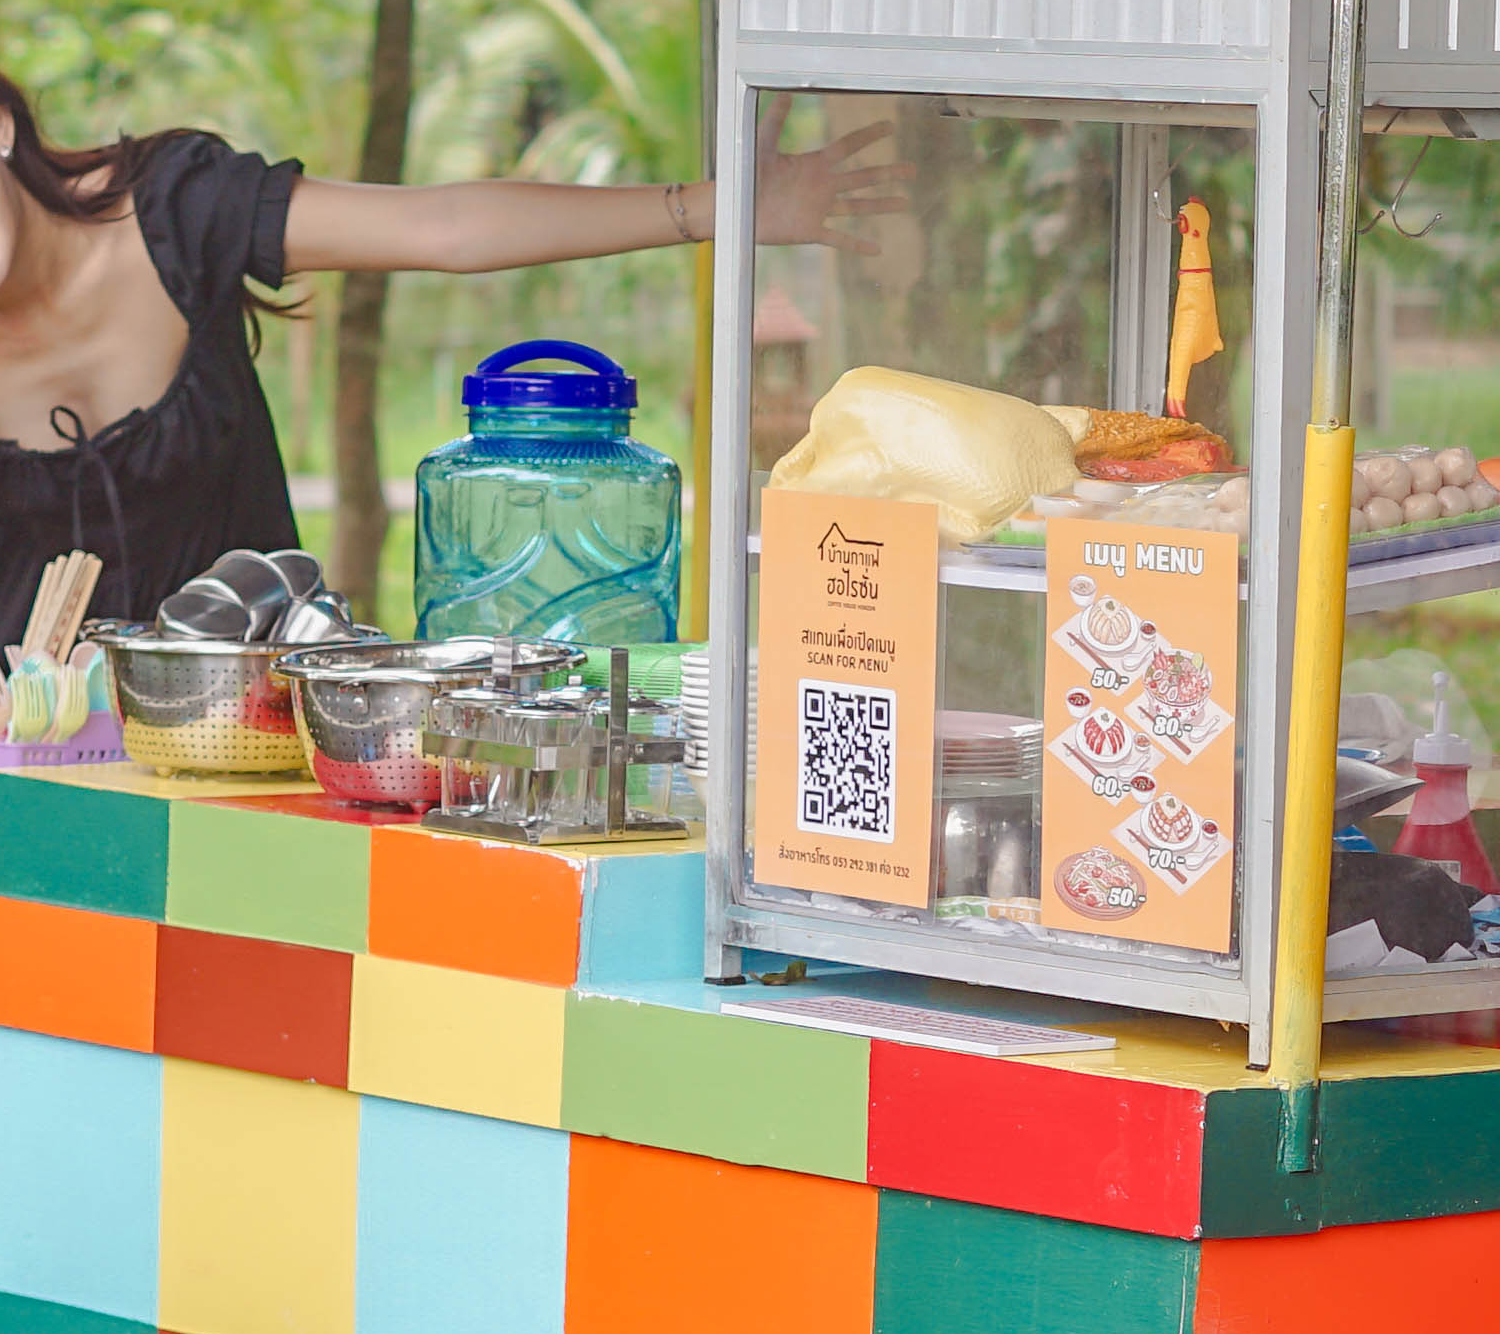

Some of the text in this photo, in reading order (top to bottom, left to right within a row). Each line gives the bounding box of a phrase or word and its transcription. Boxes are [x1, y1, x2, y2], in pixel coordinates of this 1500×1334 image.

[827, 542, 880, 568] บ้านกาแฟ
[1084, 541, 1204, 578] เมนู MENU
[826, 568, 879, 600] ฮอไรซั่น
[801, 623, 896, 663] สแกนเพื่อเปิดเมนู
[807, 651, 889, 674] SCAN FOR MENU
